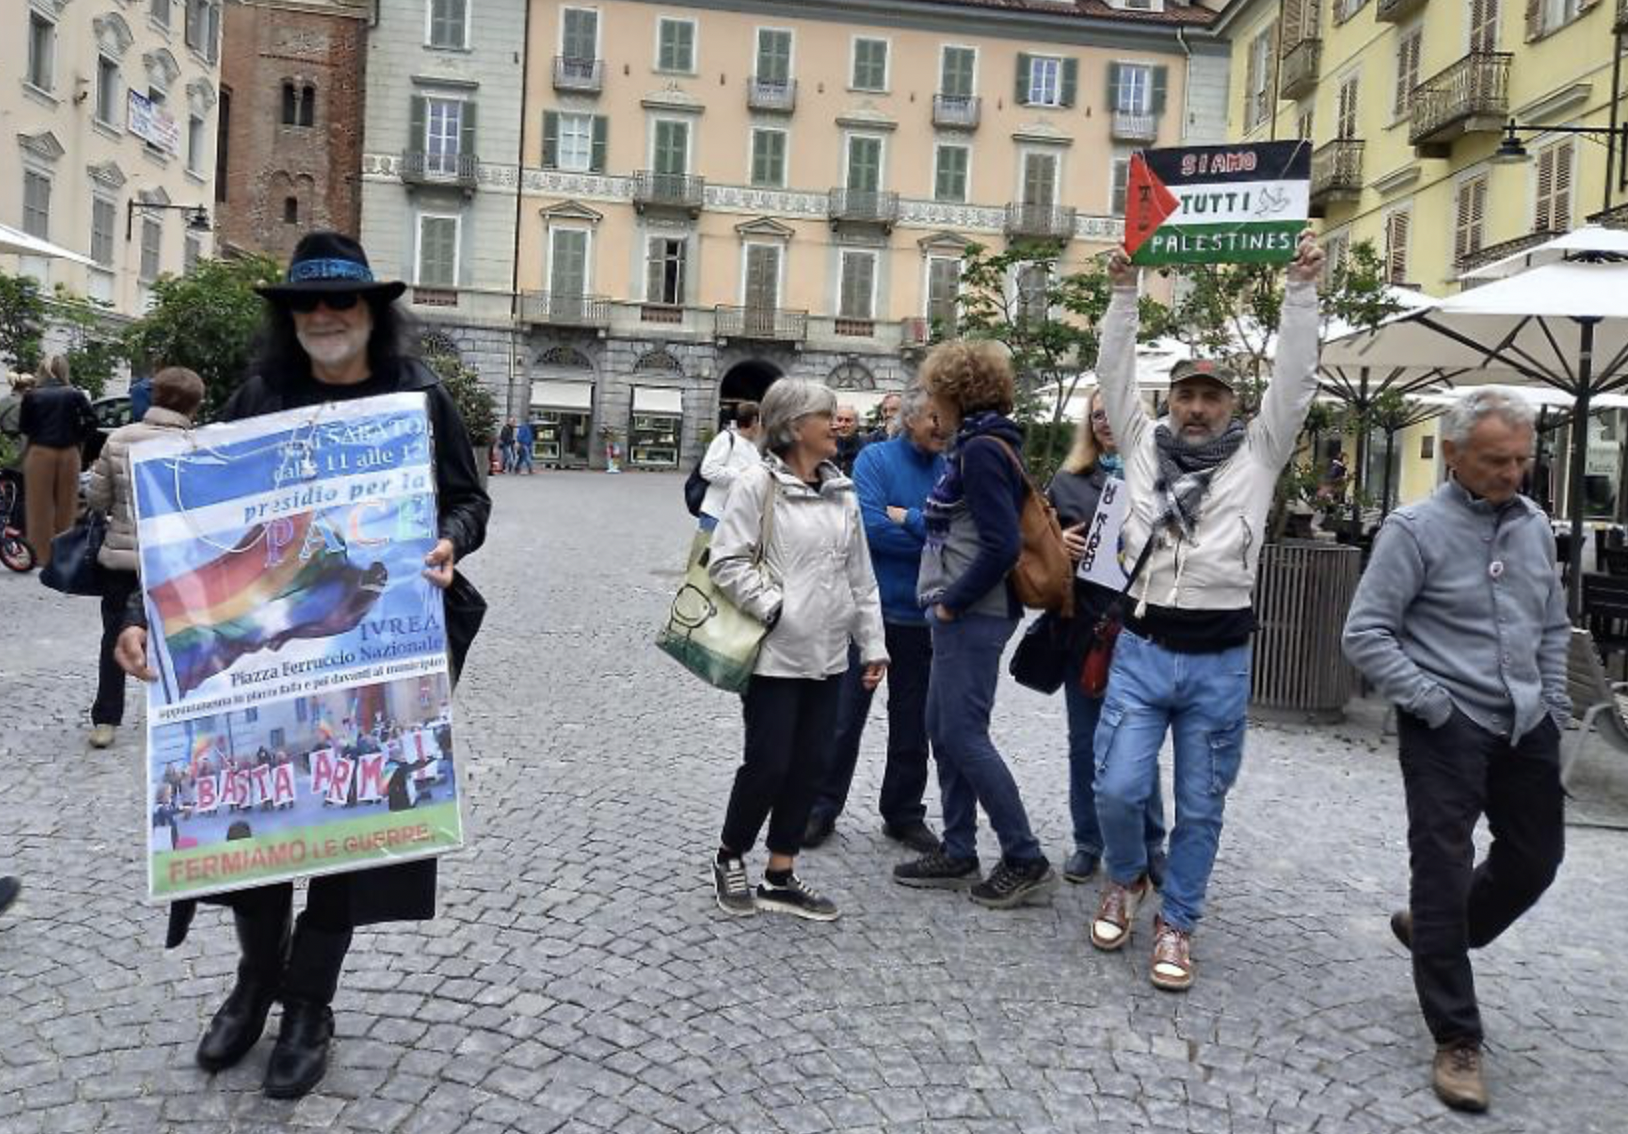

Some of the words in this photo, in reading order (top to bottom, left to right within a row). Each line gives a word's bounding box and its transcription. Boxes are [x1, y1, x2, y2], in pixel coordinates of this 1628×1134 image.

[1180, 151, 1258, 176] SIAMO
[1180, 191, 1250, 215] TUTTI
[1152, 231, 1299, 254] PALESTINESI
[327, 452, 350, 471] 11
[357, 447, 393, 467] alle
[243, 485, 338, 523] presidio
[349, 478, 392, 504] per
[402, 470, 425, 491] la
[1103, 484, 1118, 504] NO
[264, 493, 434, 568] PACE
[359, 614, 441, 641] IVREA
[230, 667, 279, 687] Piazza
[282, 649, 356, 677] Ferruccio
[360, 634, 442, 662] Nazionale
[197, 766, 294, 809] BASTA
[168, 839, 307, 886] FERMIAMO
[312, 837, 338, 860] LE
